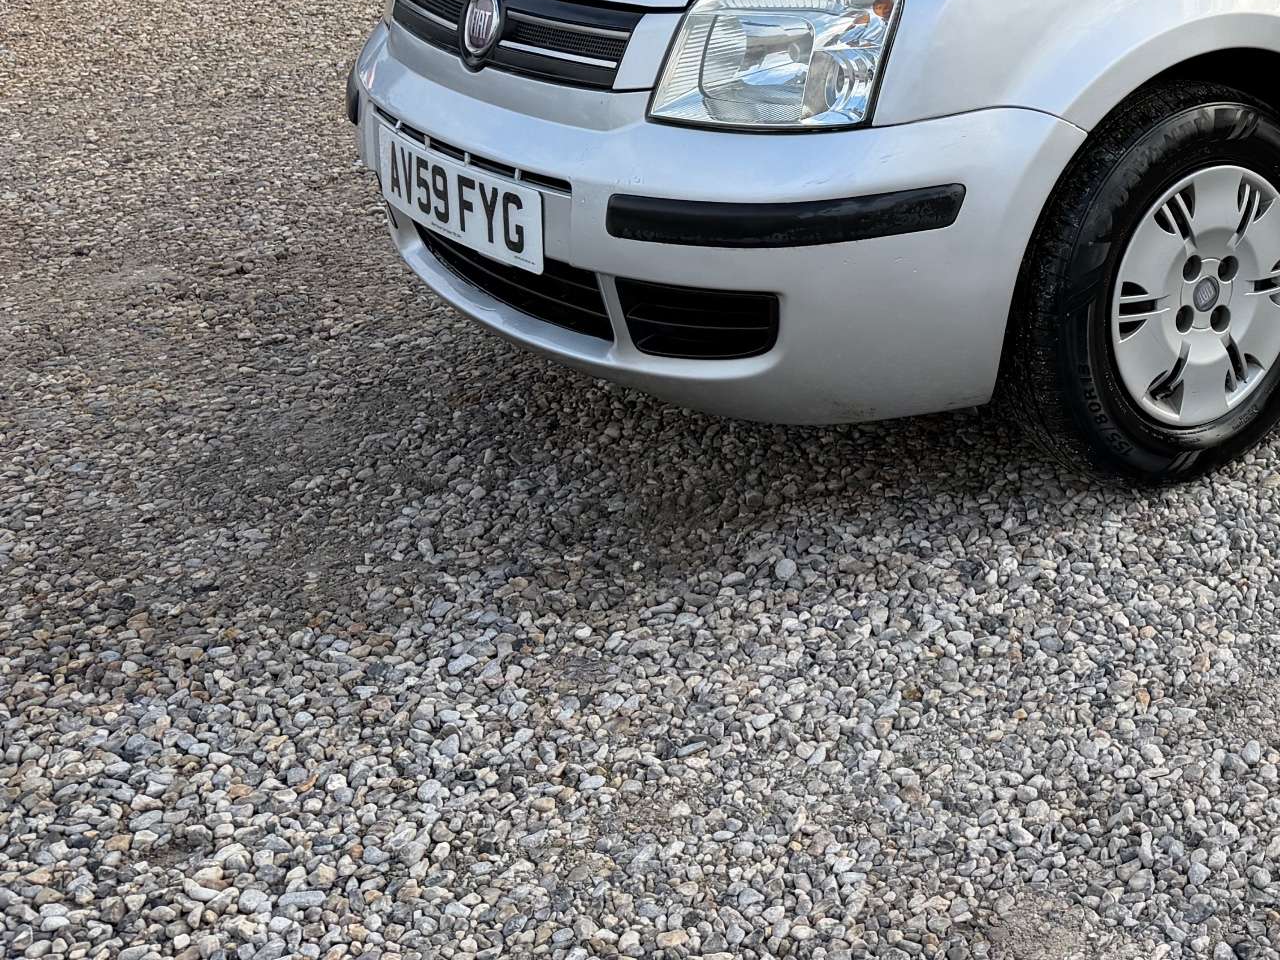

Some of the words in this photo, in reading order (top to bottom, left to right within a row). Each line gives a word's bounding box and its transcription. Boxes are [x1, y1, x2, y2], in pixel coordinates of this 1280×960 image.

[470, 7, 492, 39] FIAT
[391, 141, 450, 224] AV59
[457, 174, 525, 254] FYG
